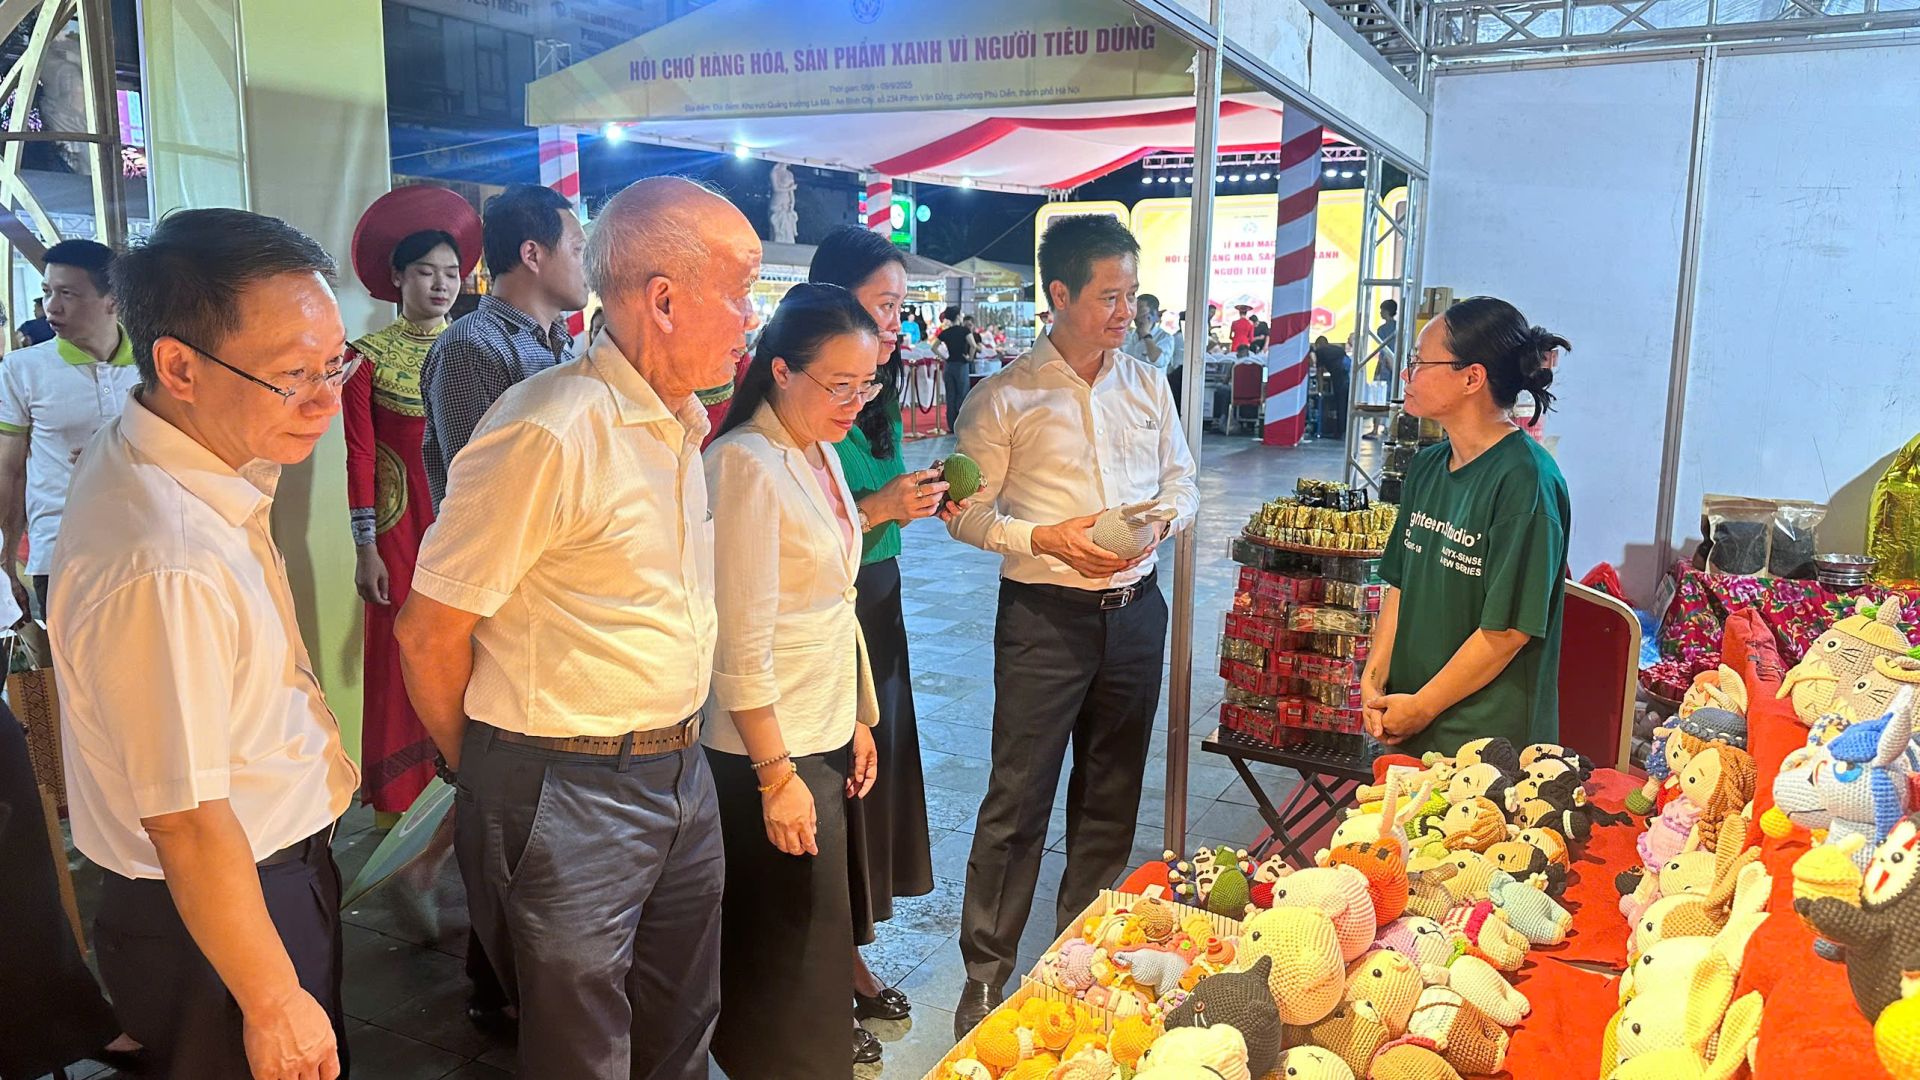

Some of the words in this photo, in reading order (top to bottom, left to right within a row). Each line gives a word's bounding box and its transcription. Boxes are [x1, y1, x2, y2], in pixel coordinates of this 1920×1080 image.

[629, 56, 656, 85] HỘI
[662, 54, 695, 82] CHỢ
[700, 51, 745, 78] HÀNG
[750, 48, 789, 75] HÓA,
[794, 43, 828, 72] SẢN
[835, 36, 886, 70] PHẨM
[892, 41, 942, 66] XANH
[949, 34, 968, 63] VÌ
[975, 29, 1037, 60] NGƯỜI
[1044, 26, 1089, 56] TIÊU
[1096, 24, 1156, 52] DÙNG
[1455, 562, 1482, 577] SERIES
